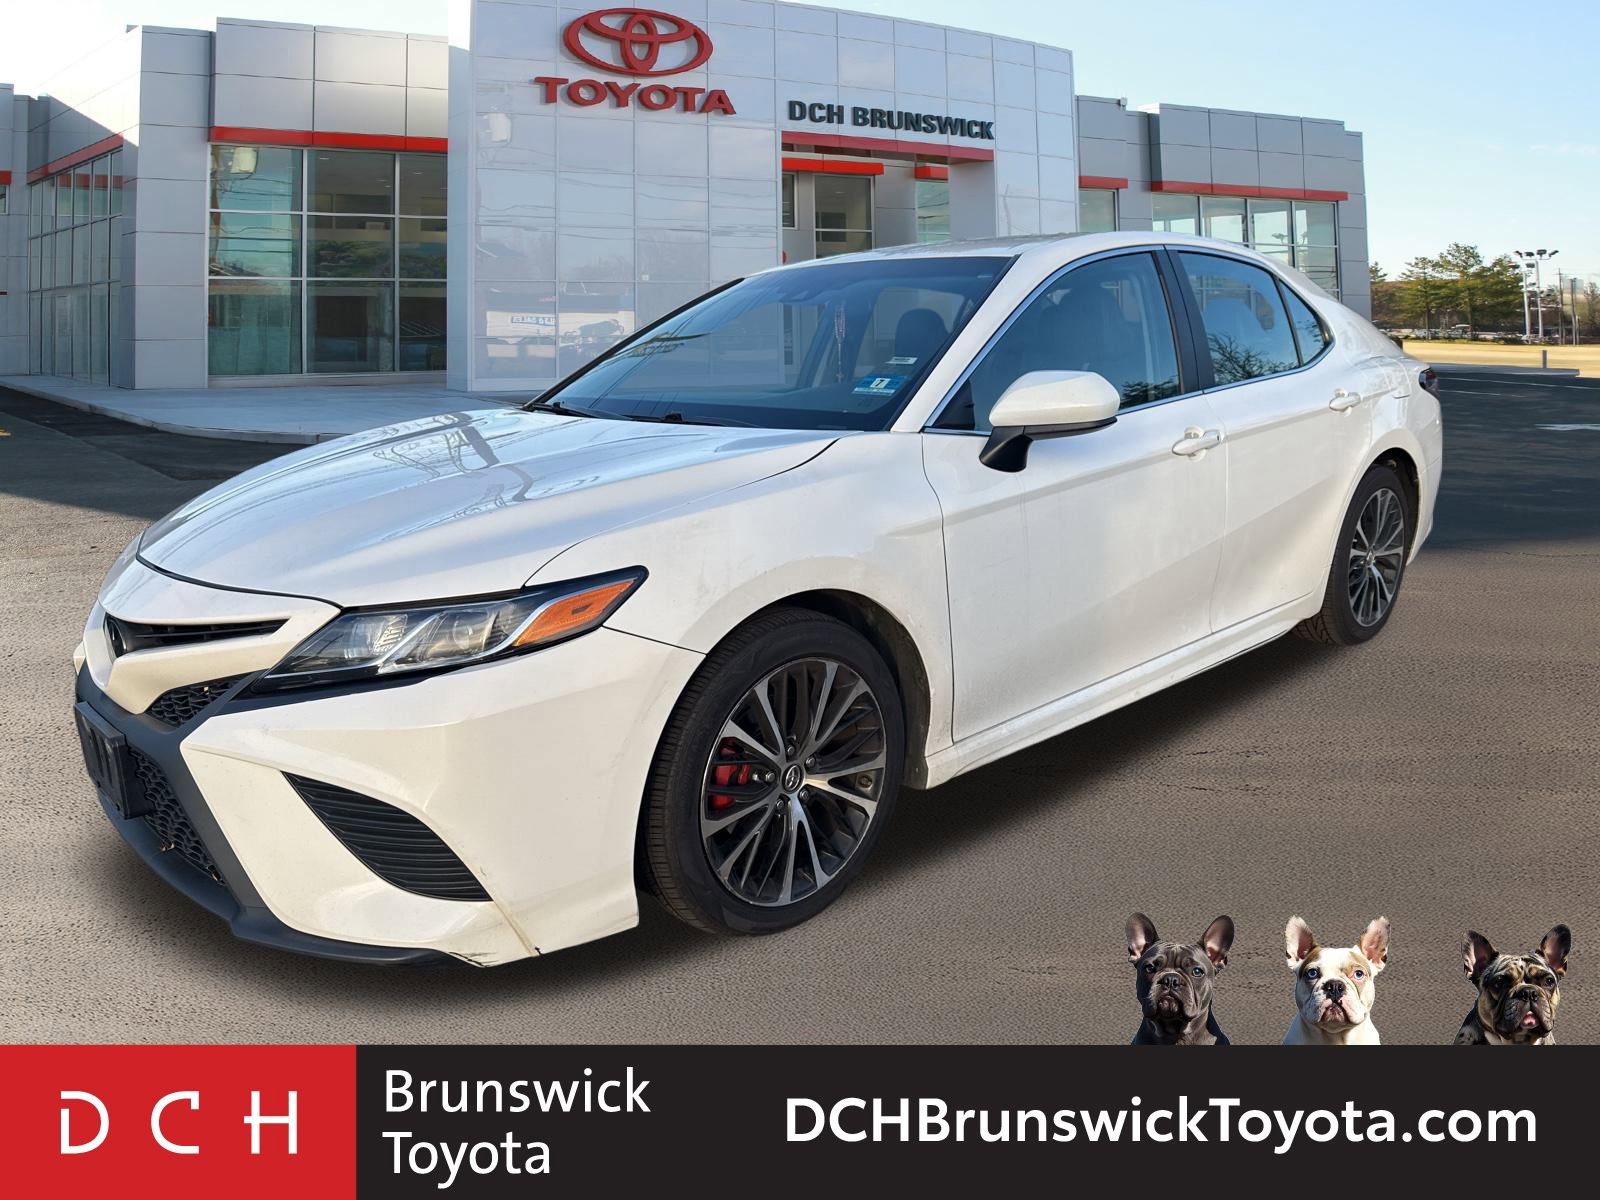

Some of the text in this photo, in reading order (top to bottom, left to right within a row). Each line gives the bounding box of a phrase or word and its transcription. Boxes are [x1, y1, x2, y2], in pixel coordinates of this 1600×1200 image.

[534, 76, 736, 115] TOYOTA
[788, 100, 995, 140] DCH BRUNSWICK
